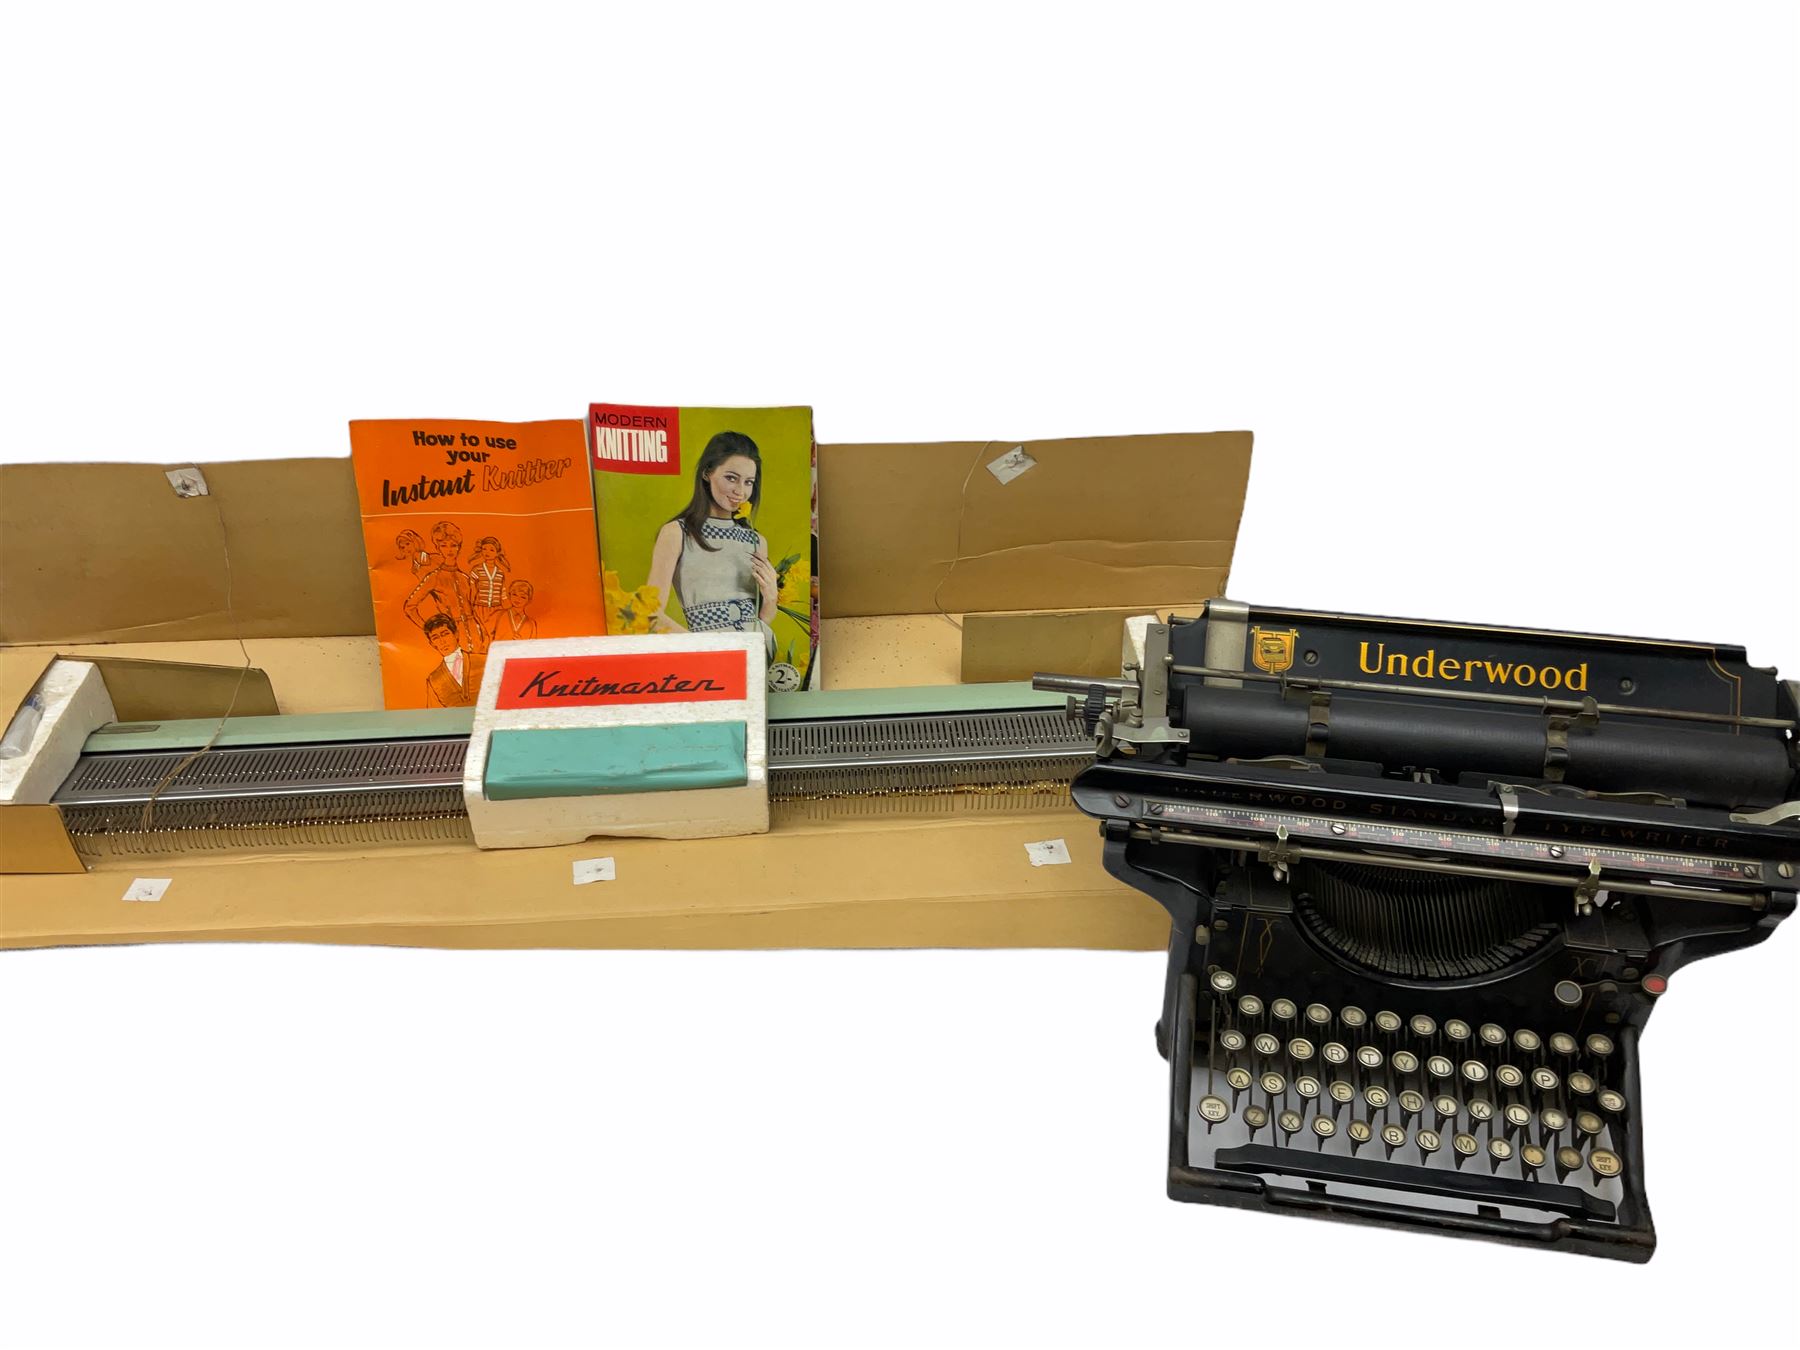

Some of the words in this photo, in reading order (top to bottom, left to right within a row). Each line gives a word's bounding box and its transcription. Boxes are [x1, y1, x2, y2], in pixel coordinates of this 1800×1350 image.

[595, 412, 668, 428] MODERN
[412, 430, 455, 447] How
[460, 432, 480, 447] to
[485, 436, 517, 450] use
[596, 426, 669, 463] KNITTING
[446, 450, 491, 466] your
[382, 469, 476, 507] Instant
[482, 457, 572, 492] Knitter
[1359, 641, 1588, 692] Underwood
[519, 670, 725, 698] Knitmaster
[1369, 803, 1499, 825] STANDAR
[1259, 1040, 1273, 1052] W
[1296, 1045, 1307, 1056] E
[1330, 1048, 1341, 1060] R
[1364, 1053, 1375, 1065] T
[1400, 1058, 1410, 1069] Y
[1434, 1062, 1446, 1074] U
[1503, 1071, 1516, 1083] O
[1541, 1075, 1551, 1086] P
[1207, 1109, 1220, 1118] KEY
[1235, 1075, 1245, 1087] A
[1268, 1078, 1278, 1090] S
[1303, 1082, 1315, 1094] D
[1337, 1087, 1347, 1099] F
[1370, 1092, 1383, 1104] G
[1406, 1096, 1418, 1108] H
[1441, 1100, 1450, 1113] J
[1476, 1104, 1488, 1117] K
[1513, 1110, 1524, 1122] L
[1251, 1111, 1261, 1123] Z
[1286, 1116, 1297, 1128] X
[1318, 1120, 1330, 1132] C
[1354, 1127, 1365, 1137] V
[1389, 1130, 1399, 1142] B
[1423, 1135, 1434, 1147] N
[1458, 1139, 1473, 1151] M
